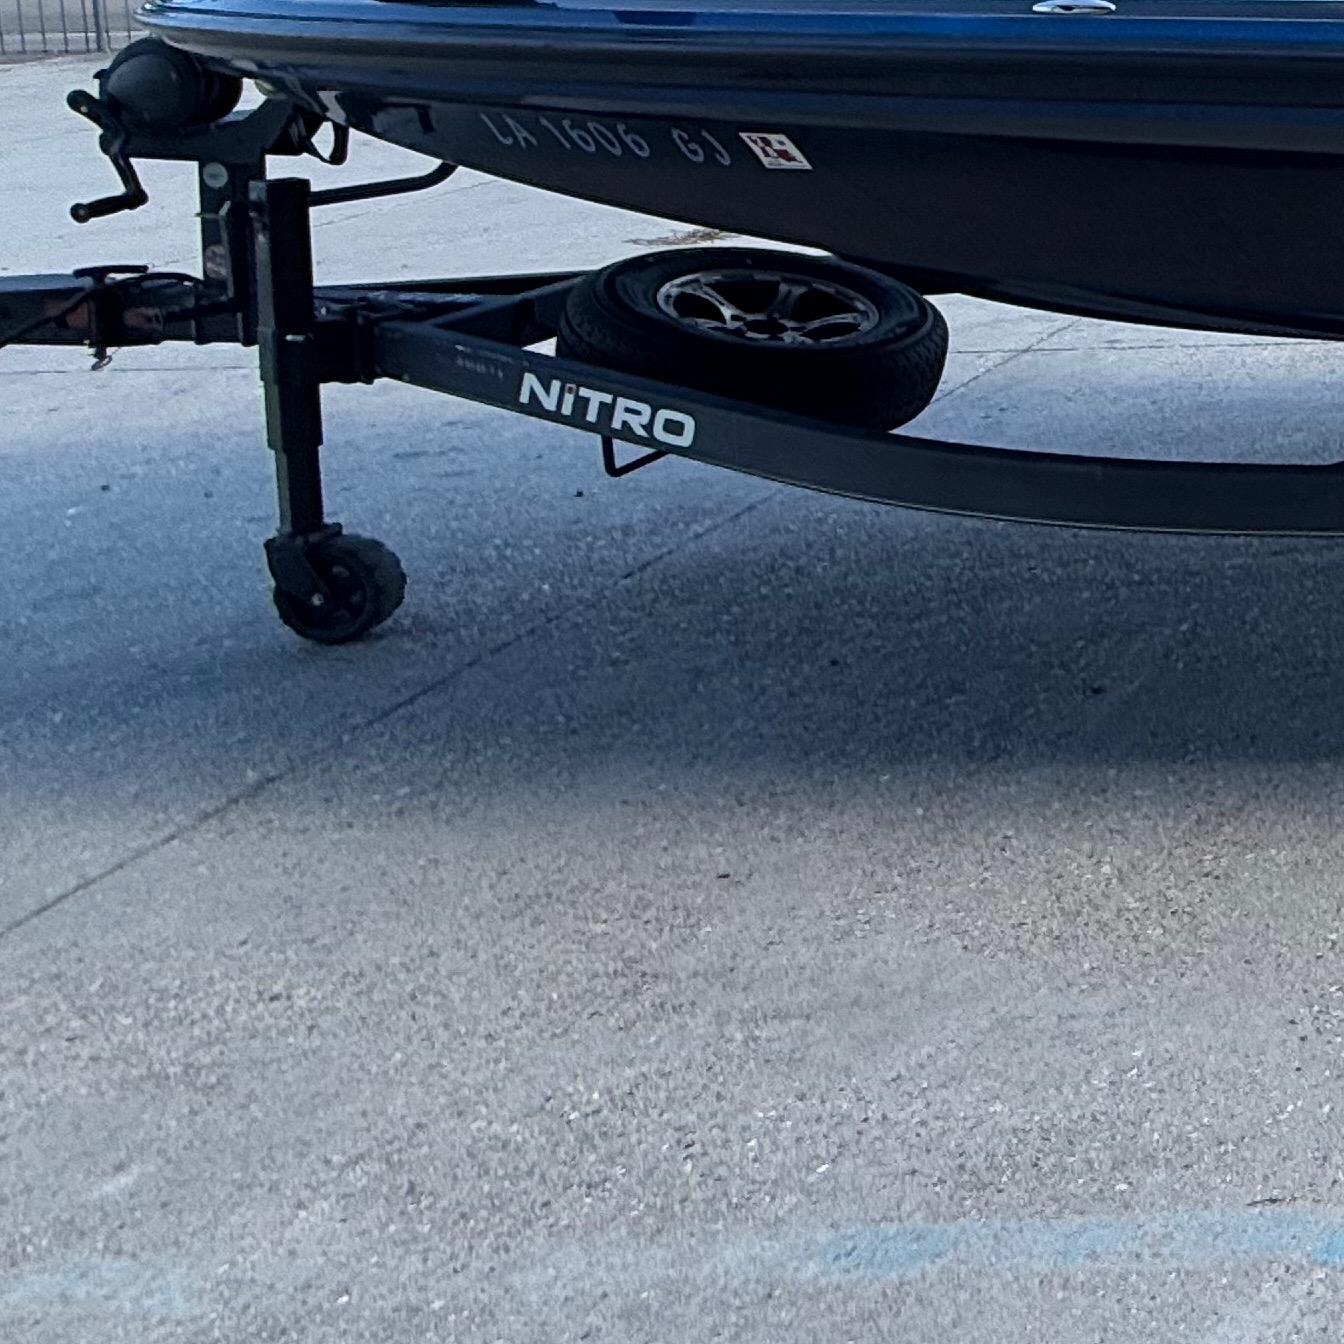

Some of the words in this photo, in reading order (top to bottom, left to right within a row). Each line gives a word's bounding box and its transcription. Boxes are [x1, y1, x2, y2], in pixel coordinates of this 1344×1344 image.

[480, 112, 539, 150] LA
[539, 115, 651, 158] 1606
[519, 371, 696, 449] NITRO
